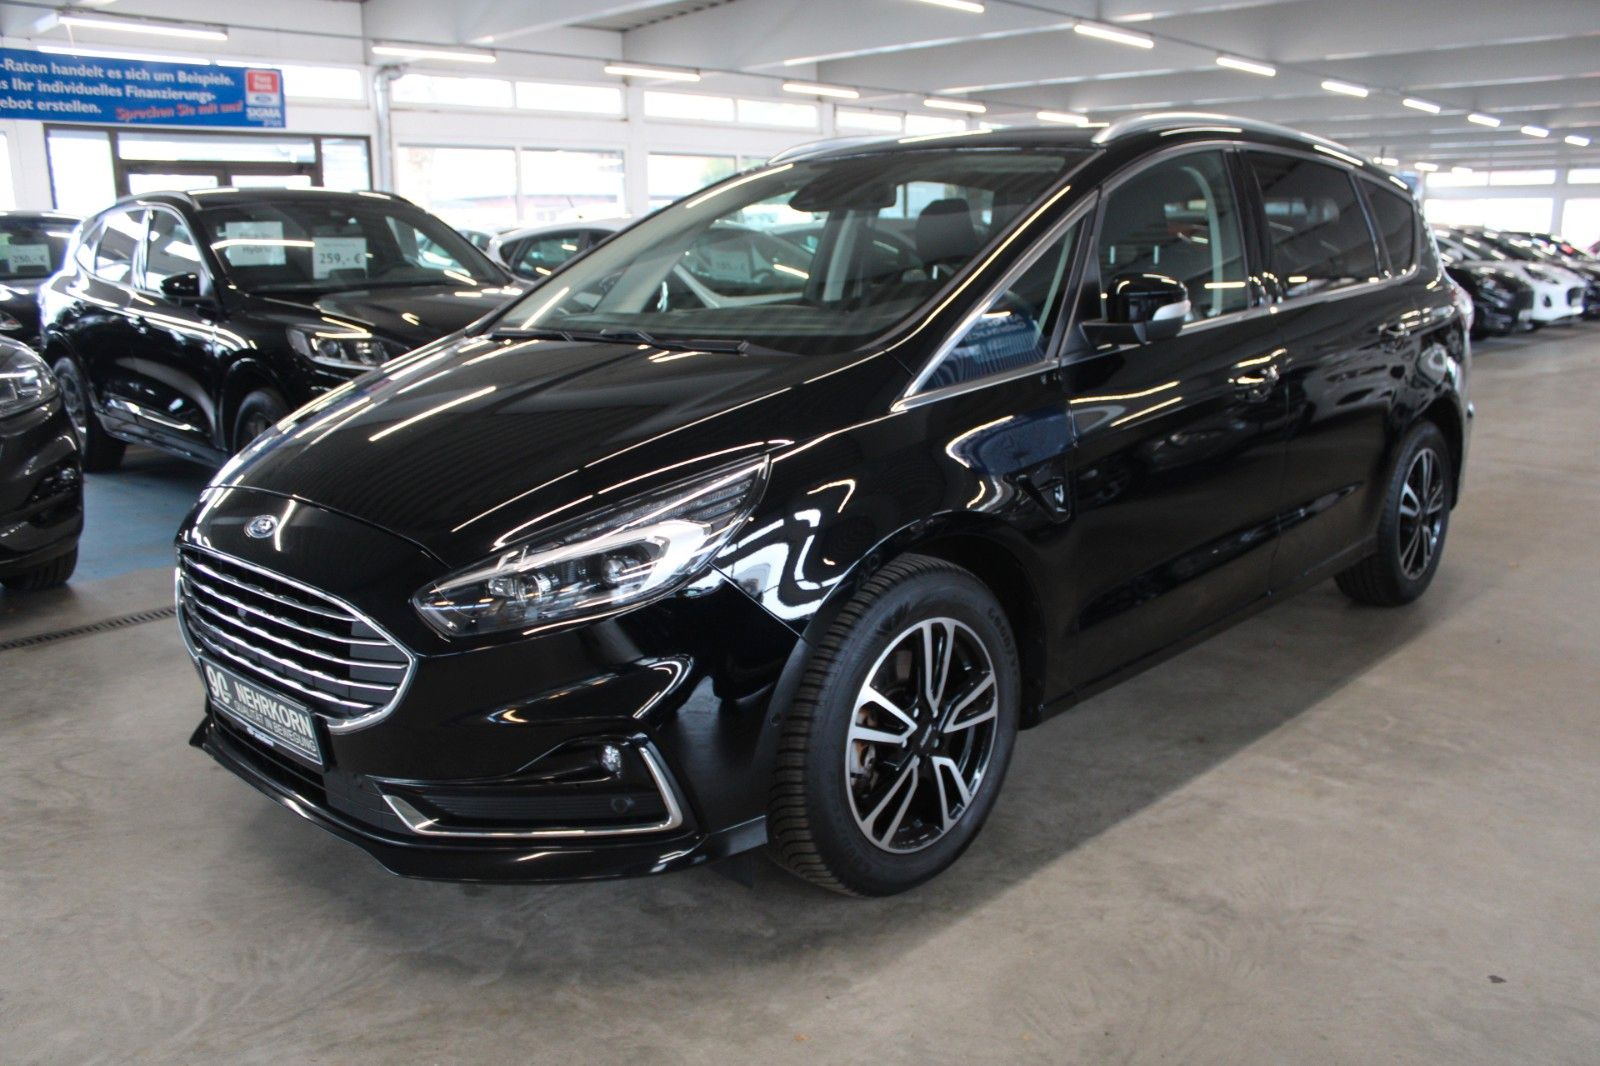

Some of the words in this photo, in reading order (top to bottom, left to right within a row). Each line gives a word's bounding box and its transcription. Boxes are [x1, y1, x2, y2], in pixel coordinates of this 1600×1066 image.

[51, 62, 104, 78] handelt
[107, 69, 122, 79] es
[125, 68, 150, 81] sich
[153, 72, 175, 82] um
[177, 70, 235, 87] Beispiele.
[12, 77, 34, 92] Ihr
[37, 80, 122, 97] individuelles
[125, 84, 216, 104] Finanzierungs-
[0, 96, 34, 111] ebot
[37, 100, 101, 113] erstellen.
[234, 681, 314, 739] NEHRKORN
